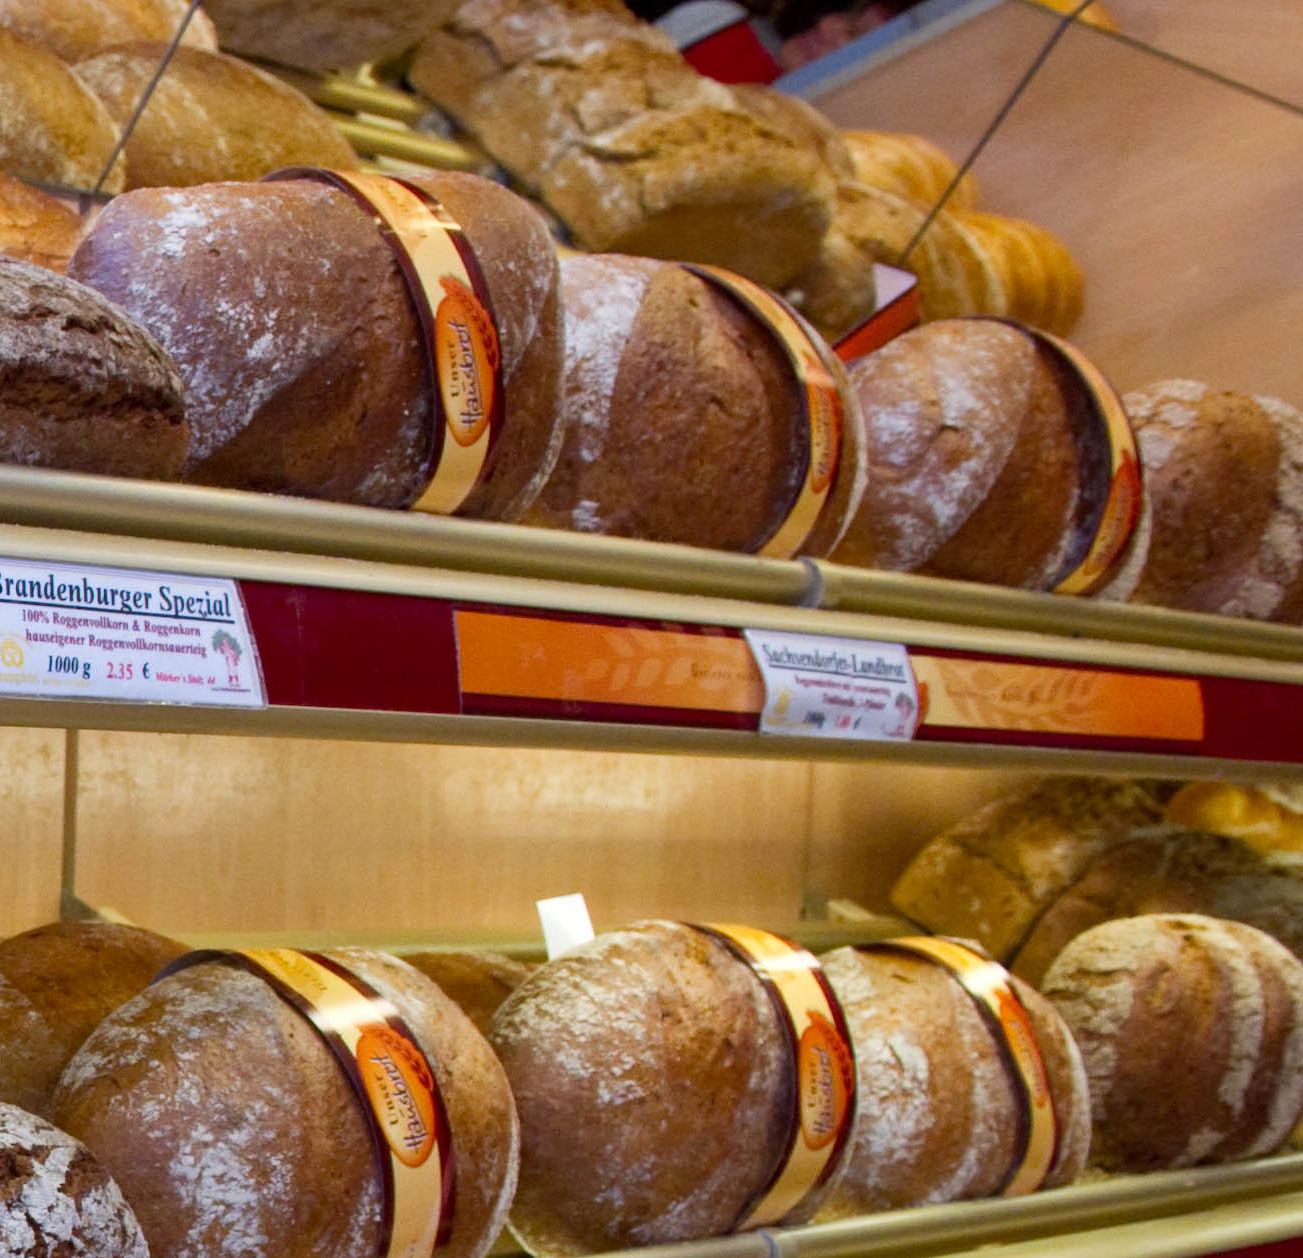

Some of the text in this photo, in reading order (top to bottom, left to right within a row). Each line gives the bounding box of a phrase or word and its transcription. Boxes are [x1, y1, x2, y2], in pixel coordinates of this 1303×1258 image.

[448, 339, 460, 398] Unser
[159, 586, 231, 617] Spezial
[22, 609, 201, 637] 100% Roggenvollkorn & Roggenkorn
[25, 628, 207, 659] hauseigener Roggenvollkornsauerteig
[47, 655, 79, 674] 1000
[82, 662, 91, 680] g
[106, 661, 133, 680] 2.35
[143, 662, 150, 680] €
